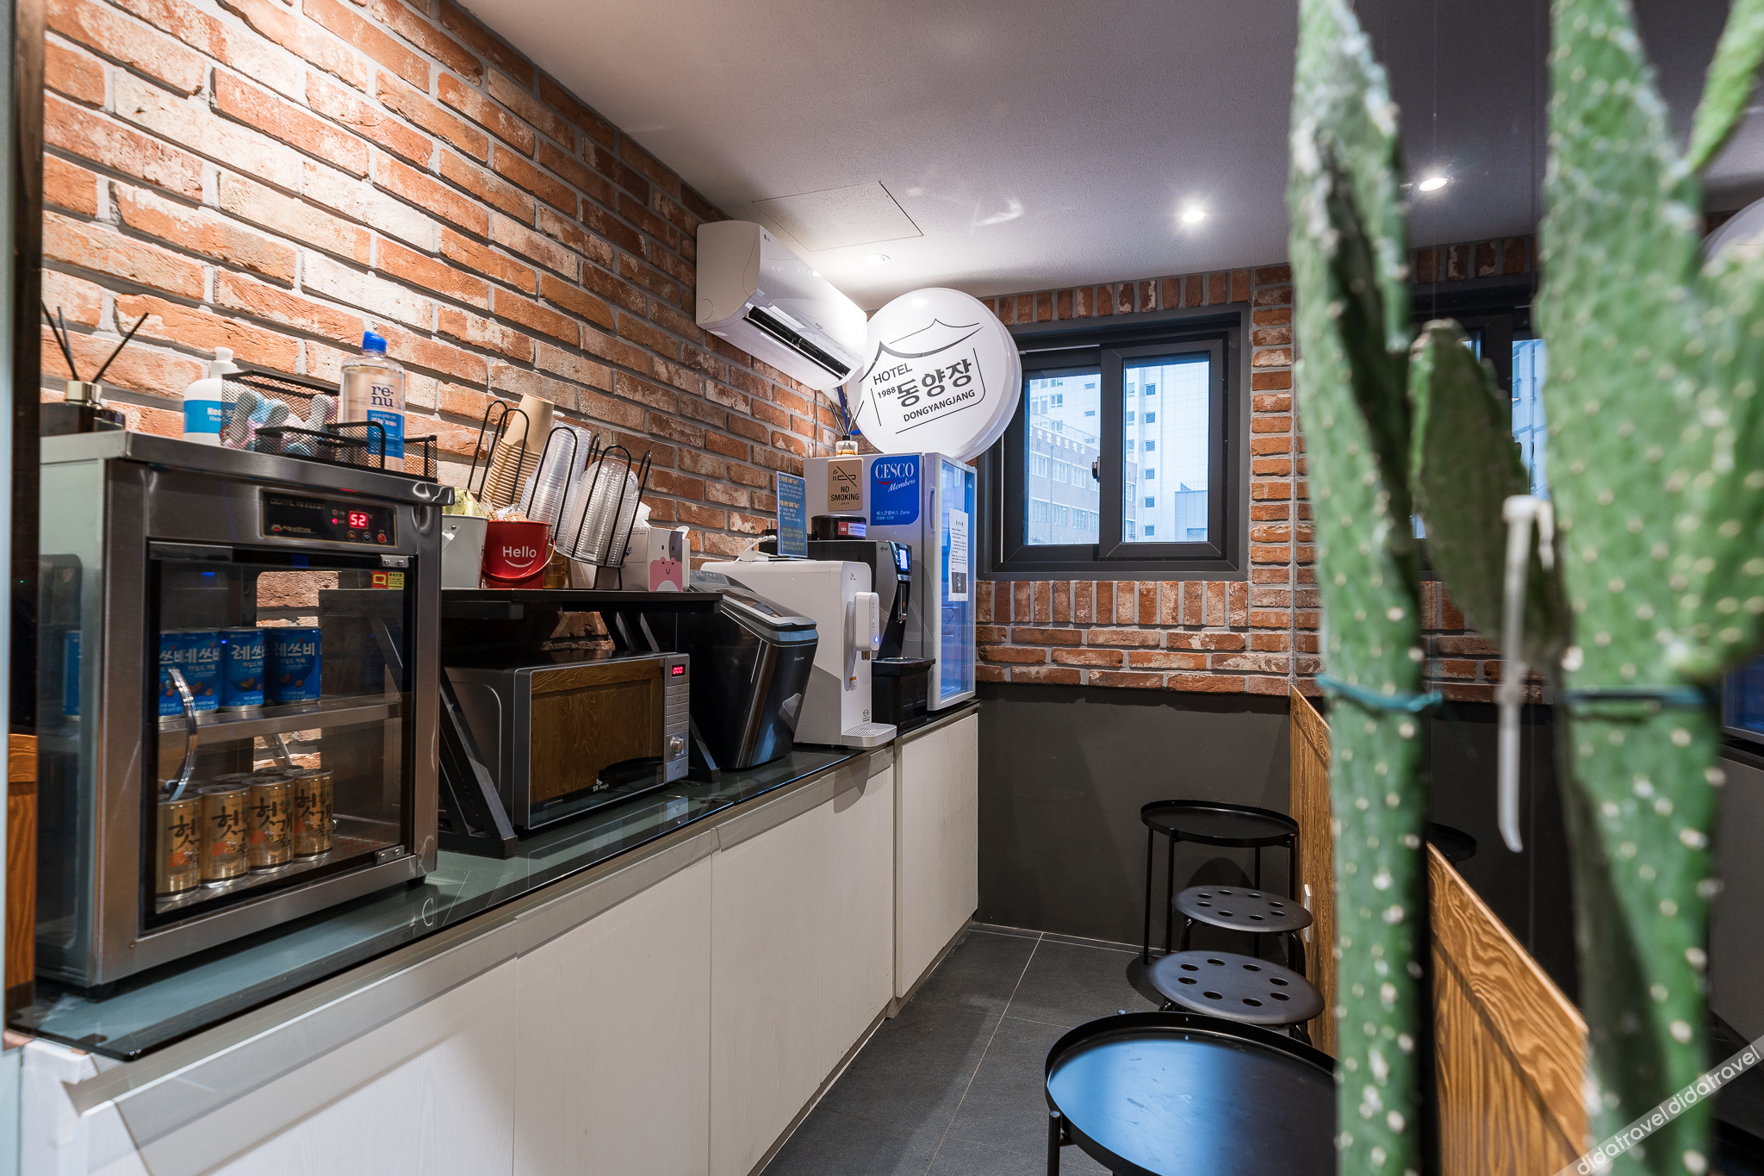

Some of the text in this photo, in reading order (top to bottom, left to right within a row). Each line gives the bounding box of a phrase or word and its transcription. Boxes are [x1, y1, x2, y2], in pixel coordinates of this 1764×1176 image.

[873, 362, 913, 385] HOTEL
[877, 358, 972, 408] 1988 동양장
[371, 395, 394, 408] nu
[903, 389, 976, 422] DONGYANGJANG
[875, 462, 915, 479] CESCO
[840, 485, 850, 493] NO
[887, 477, 916, 493] Members
[830, 493, 860, 502] SMOKING
[350, 513, 368, 528] 52
[502, 545, 537, 558] Hello
